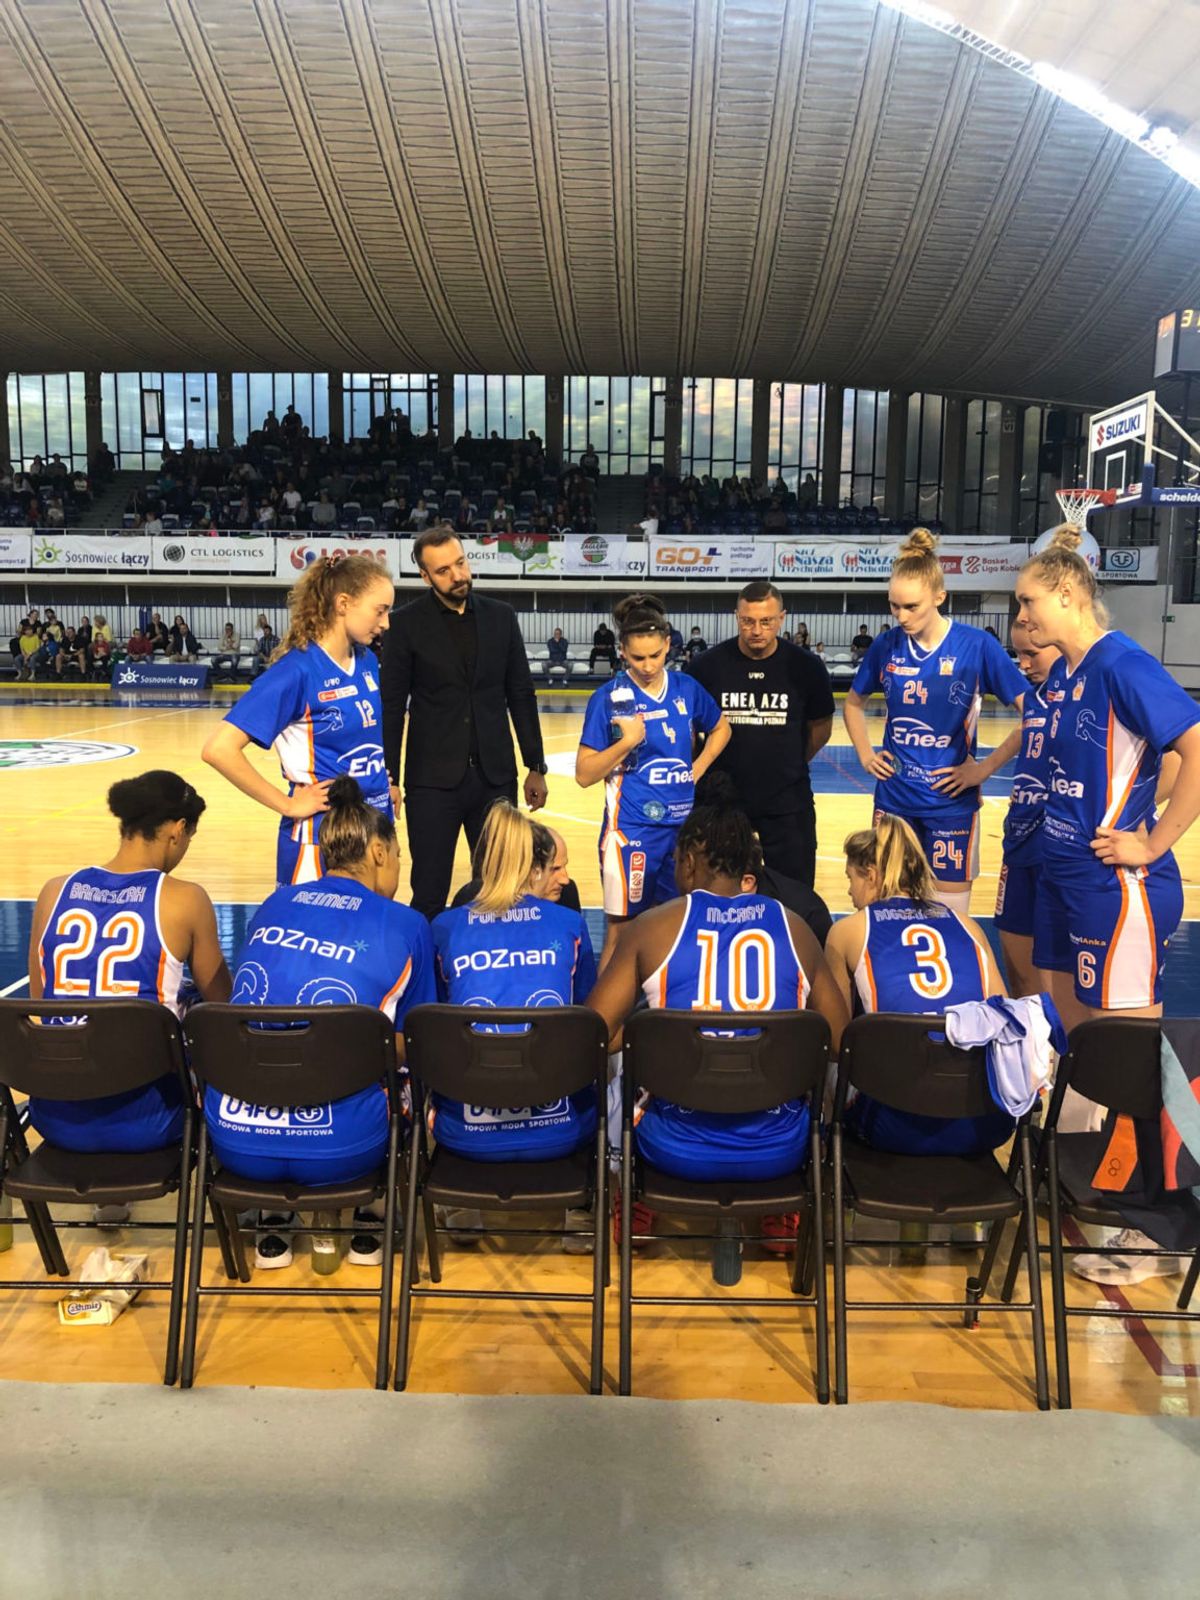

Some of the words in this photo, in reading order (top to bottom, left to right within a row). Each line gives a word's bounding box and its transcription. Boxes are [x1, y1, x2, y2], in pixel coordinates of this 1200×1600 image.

[1106, 414, 1141, 440] SUZUKI
[65, 550, 119, 563] Sosnowiec
[121, 551, 149, 567] łączy
[191, 548, 209, 557] CTL
[795, 555, 834, 565] Nasza
[627, 561, 646, 574] czy
[655, 565, 720, 573] TRANSPORT
[845, 565, 892, 573] Przychodni
[982, 565, 998, 573] Liga
[140, 675, 177, 684] Sosnowiec
[179, 676, 199, 686] łączy
[721, 692, 756, 708] ENEA
[761, 693, 789, 709] AZS
[903, 680, 928, 705] 24
[355, 699, 377, 728] 12
[1051, 709, 1061, 739] 6
[662, 721, 676, 744] 4
[892, 727, 952, 748] Enea
[1026, 732, 1045, 759] 13
[348, 757, 386, 777] En
[932, 840, 964, 870] 24
[292, 890, 363, 911] REIMER
[53, 907, 145, 997] 22
[901, 923, 954, 999] 3
[691, 928, 776, 1012] 10
[1078, 951, 1097, 989] 6
[218, 1119, 251, 1133] TOPOWA
[255, 1127, 282, 1136] MODA
[464, 1124, 497, 1132] TOPOWA
[502, 1122, 526, 1130] MODA
[529, 1115, 572, 1127] SPORTOWA
